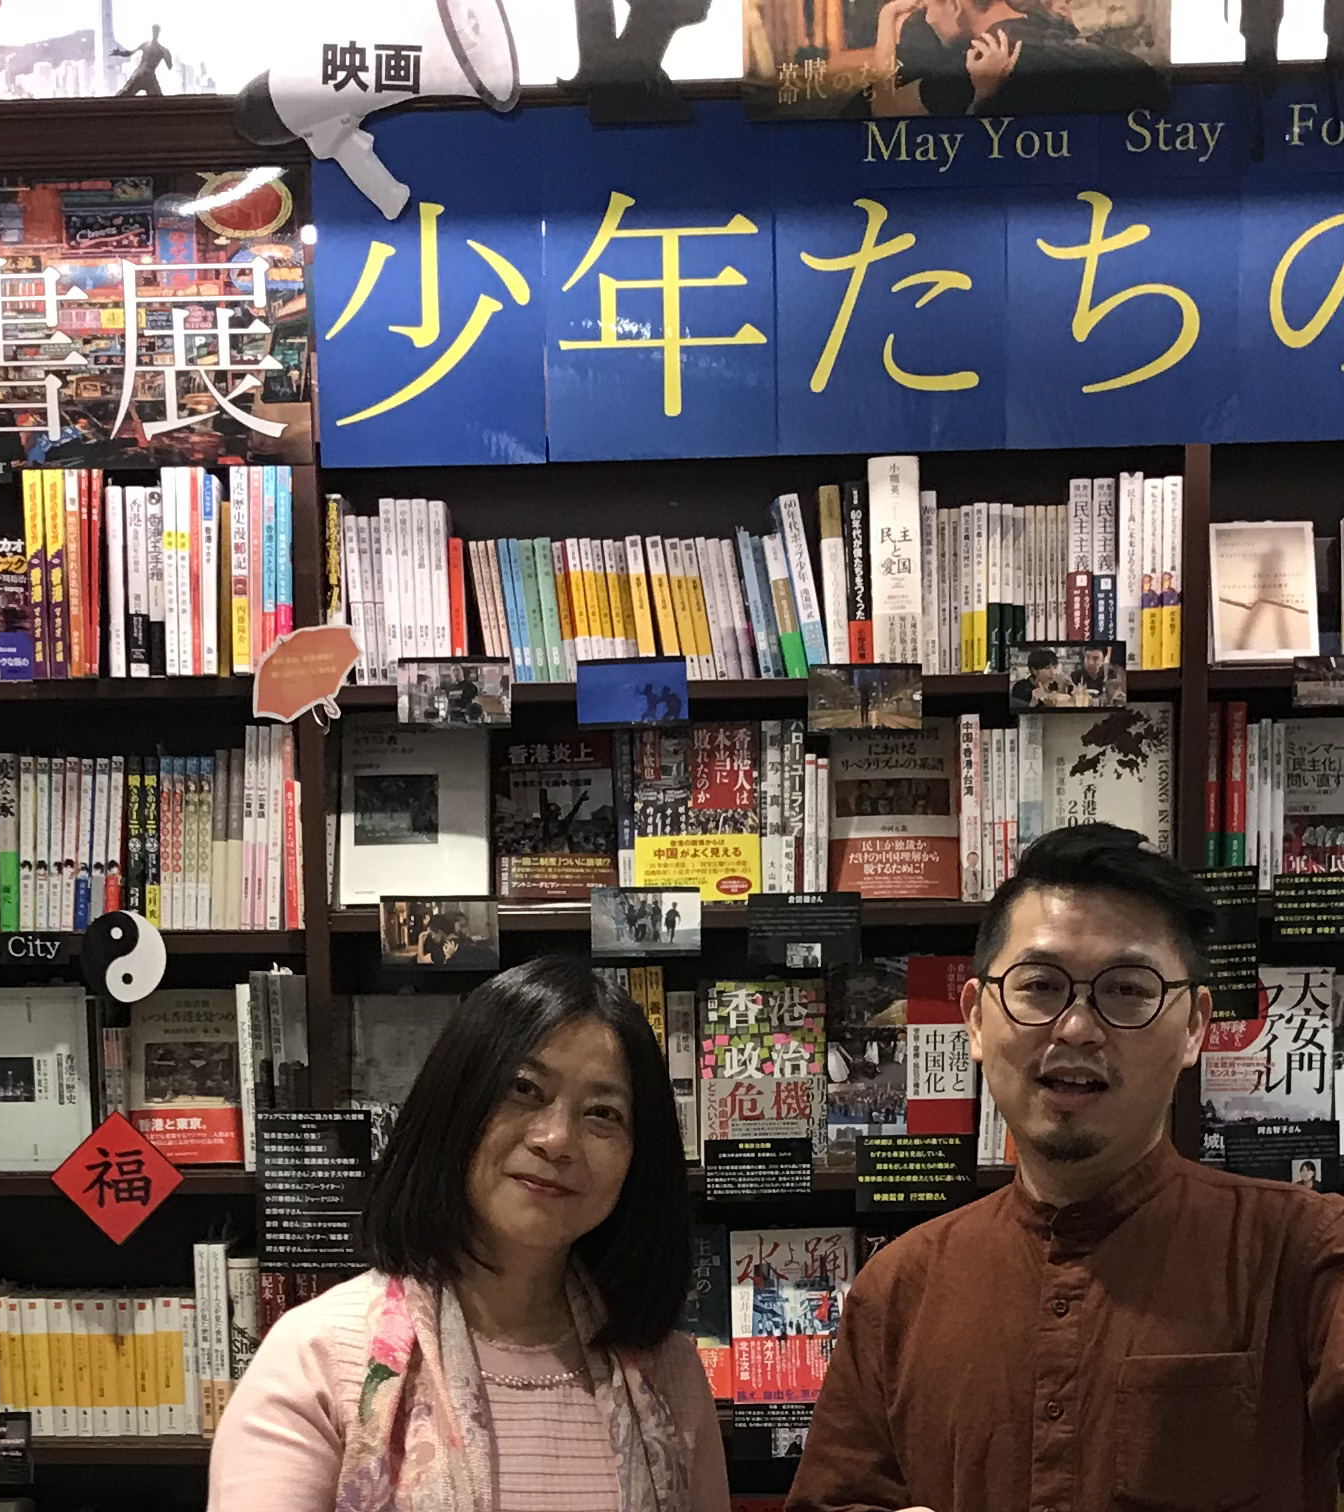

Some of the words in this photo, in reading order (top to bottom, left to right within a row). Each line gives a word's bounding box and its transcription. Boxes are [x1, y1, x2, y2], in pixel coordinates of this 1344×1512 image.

[321, 42, 423, 96] 映画
[863, 119, 964, 173] May
[978, 117, 1071, 160] You
[1126, 108, 1225, 162] Stay
[1073, 500, 1090, 572] 民主主義
[1097, 500, 1114, 572] 民主主義
[508, 743, 595, 765] 香港炎上
[693, 727, 711, 804] 敗れたのか
[715, 727, 732, 784] 本当に
[732, 727, 751, 806] 香港人は
[1286, 774, 1343, 790] 問い直す
[653, 847, 743, 860] 中国がよく見える
[7, 935, 61, 962] City
[722, 986, 808, 1029] 香港
[1249, 980, 1285, 1097] ファイル
[1284, 966, 1331, 1097] 天安門
[724, 1040, 810, 1080] 政治
[924, 1029, 946, 1093] 中国化
[949, 1029, 970, 1092] 香港と
[727, 1081, 811, 1122] 危機
[85, 1146, 153, 1210] 福
